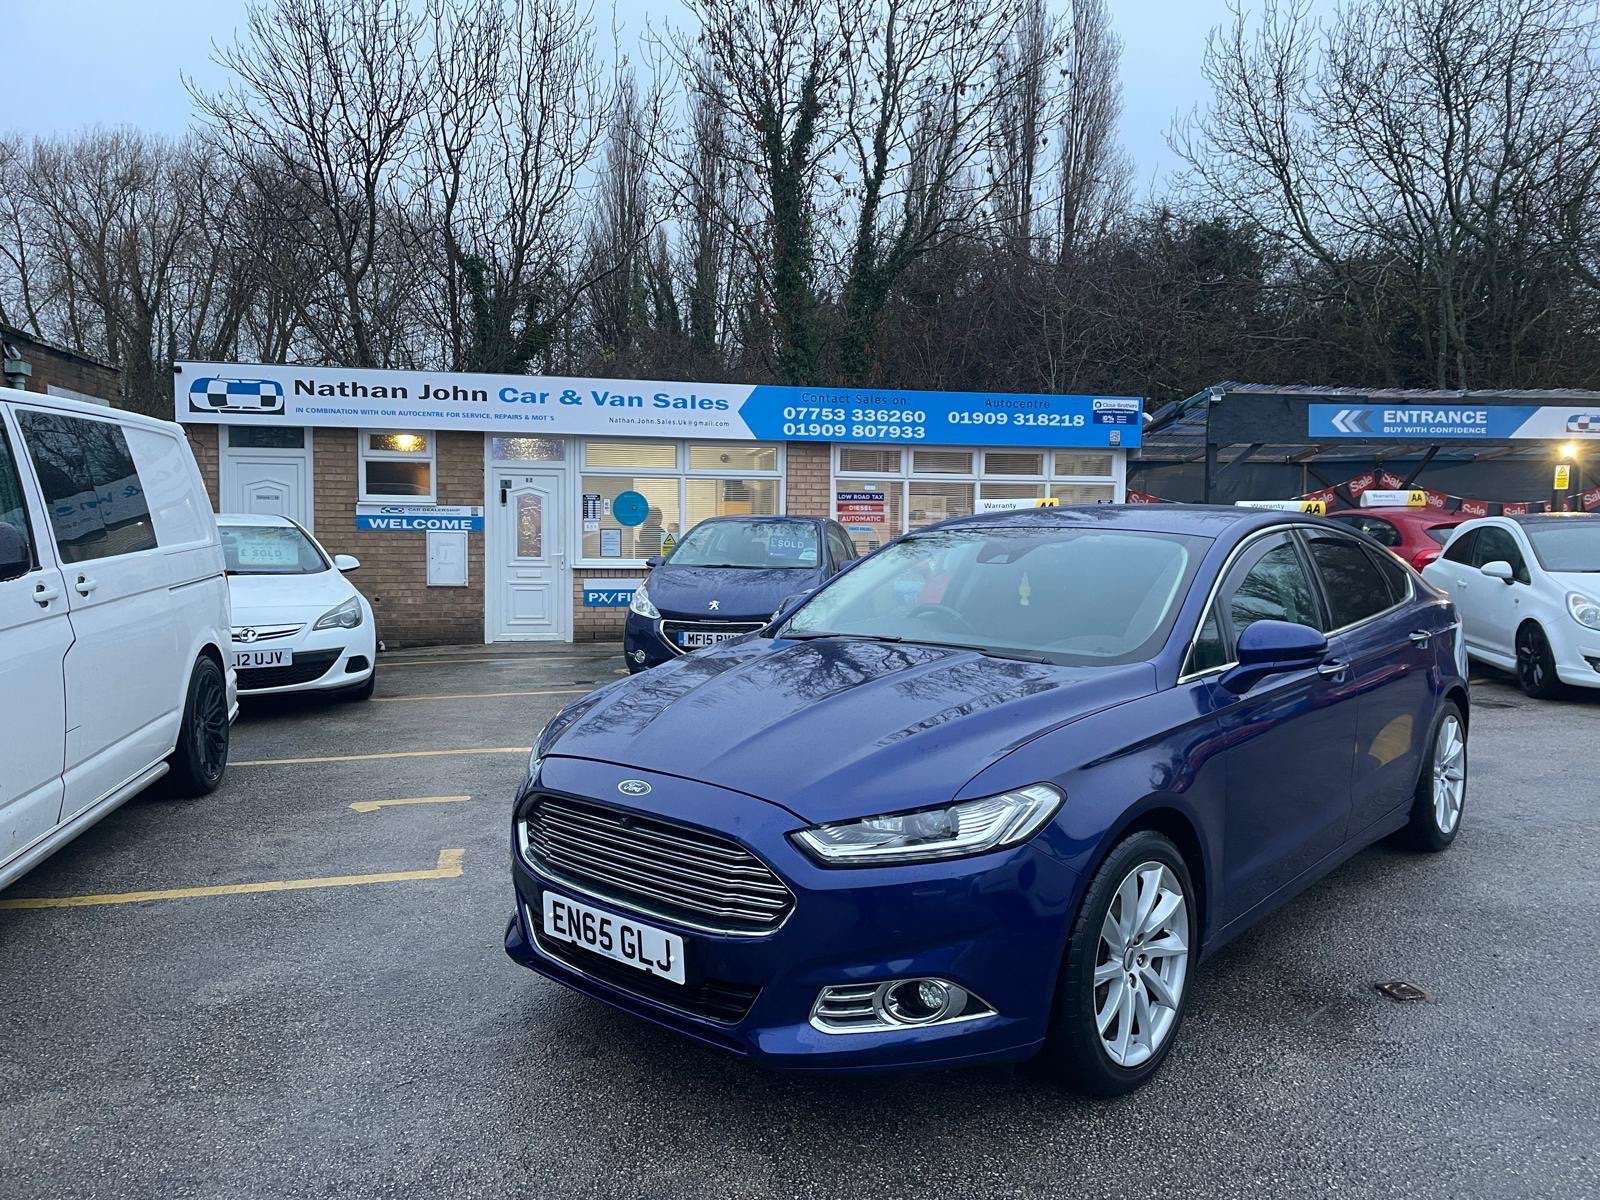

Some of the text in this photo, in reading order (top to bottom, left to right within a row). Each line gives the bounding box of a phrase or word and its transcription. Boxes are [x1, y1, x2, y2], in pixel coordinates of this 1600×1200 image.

[294, 379, 730, 411] Nathan John Car & Van Sales
[801, 392, 850, 404] Contact
[856, 394, 888, 405] Sales
[984, 398, 1050, 409] Autocentre
[305, 407, 359, 415] COMBINATION
[398, 410, 444, 418] AUTOCENTRE
[783, 406, 926, 423] 07753 336260
[947, 411, 1085, 427] 01909 318218
[1383, 410, 1488, 424] ENTRANCE
[783, 422, 926, 439] 01909 807933
[1429, 426, 1487, 434] CONFIDENCE
[1350, 475, 1373, 492] Sale
[1411, 493, 1423, 502] AA
[1305, 503, 1321, 514] AA
[1462, 503, 1486, 516] Sale
[368, 518, 473, 530] WELCOME
[778, 539, 804, 549] SOLD
[588, 592, 636, 604] PX/FI
[687, 633, 713, 645] MF15
[231, 651, 283, 667] 12 UJV
[551, 899, 672, 973] EN65 GLJ
